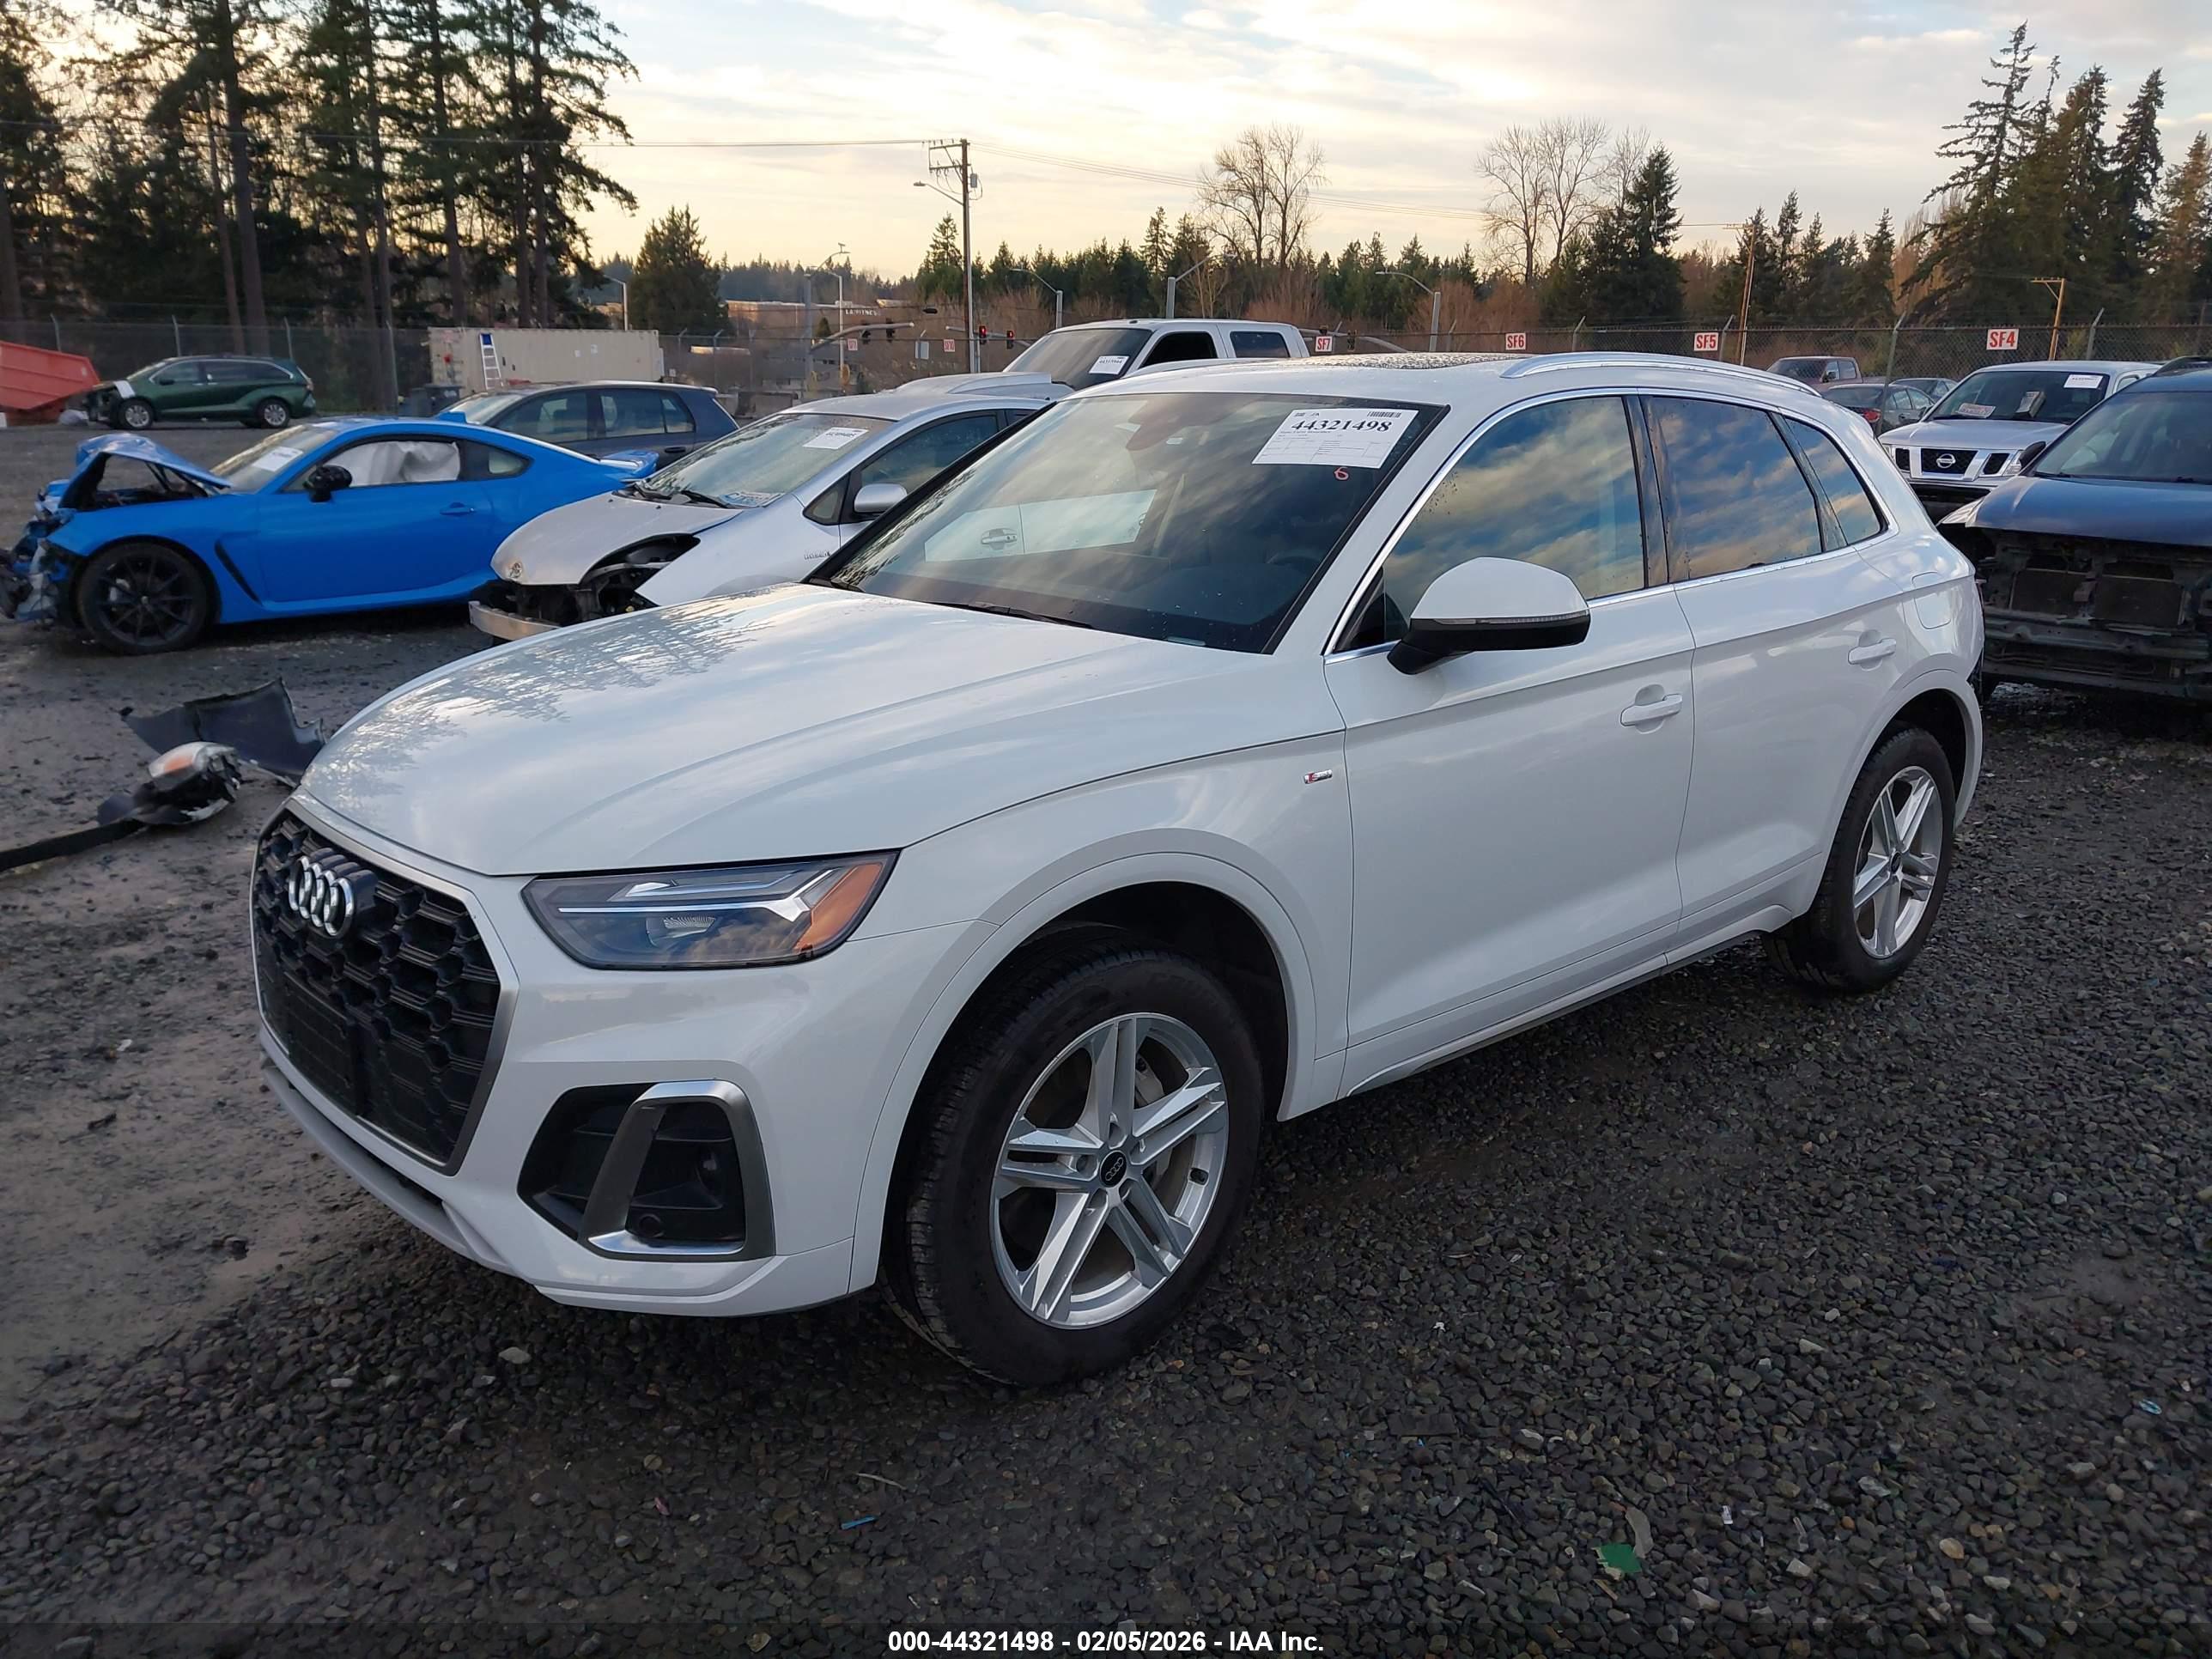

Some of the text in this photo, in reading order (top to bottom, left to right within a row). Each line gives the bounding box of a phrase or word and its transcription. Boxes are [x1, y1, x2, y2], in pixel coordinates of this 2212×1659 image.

[1317, 338, 1331, 350] SF7
[1507, 335, 1524, 348] SF6
[1696, 334, 1717, 349] SF5
[1990, 331, 2015, 347] SF4
[1291, 420, 1392, 431] 44321498
[1334, 466, 1349, 480] 6
